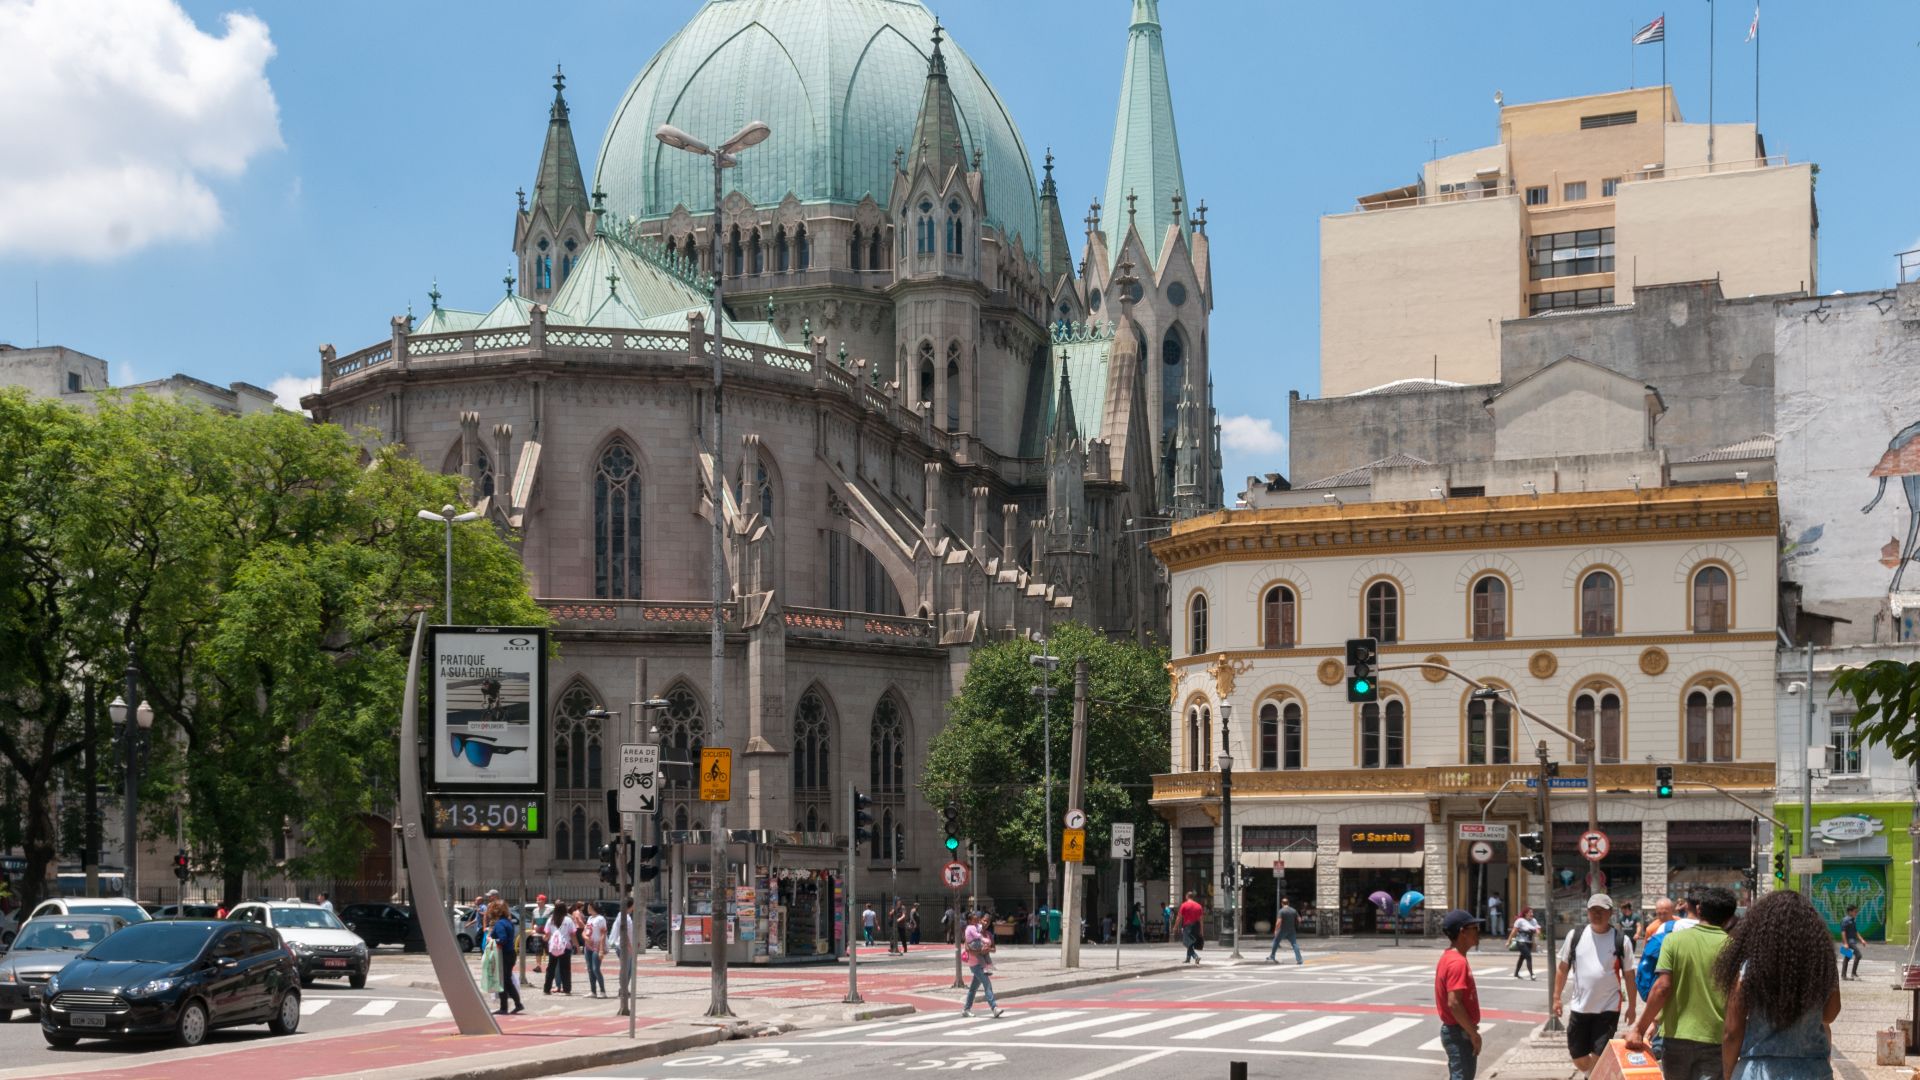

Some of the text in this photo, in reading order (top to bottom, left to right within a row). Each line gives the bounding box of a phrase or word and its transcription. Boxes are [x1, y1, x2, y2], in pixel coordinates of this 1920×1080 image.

[440, 654, 486, 666] PRATIQUE
[440, 667, 447, 678] A
[448, 667, 467, 678] SUA
[1552, 780, 1587, 788] Mendes
[448, 805, 518, 826] 13:50
[1367, 832, 1411, 842] Saraiva
